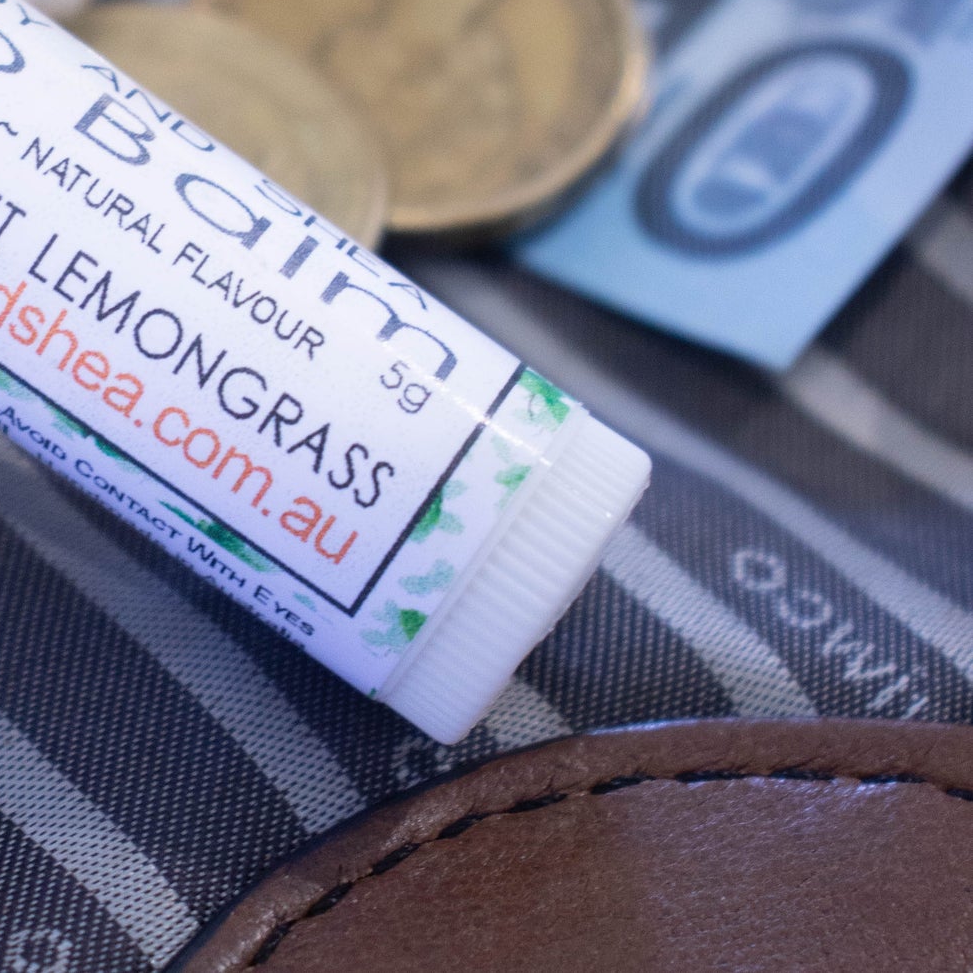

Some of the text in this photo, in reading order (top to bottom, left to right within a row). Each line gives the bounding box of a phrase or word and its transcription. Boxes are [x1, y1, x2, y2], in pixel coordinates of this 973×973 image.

[21, 136, 167, 254] NATURAL
[173, 241, 326, 361] FLAVOUR
[73, 92, 458, 383] Balm
[28, 233, 397, 509] LEMONGRASS
[380, 361, 433, 414] 5g
